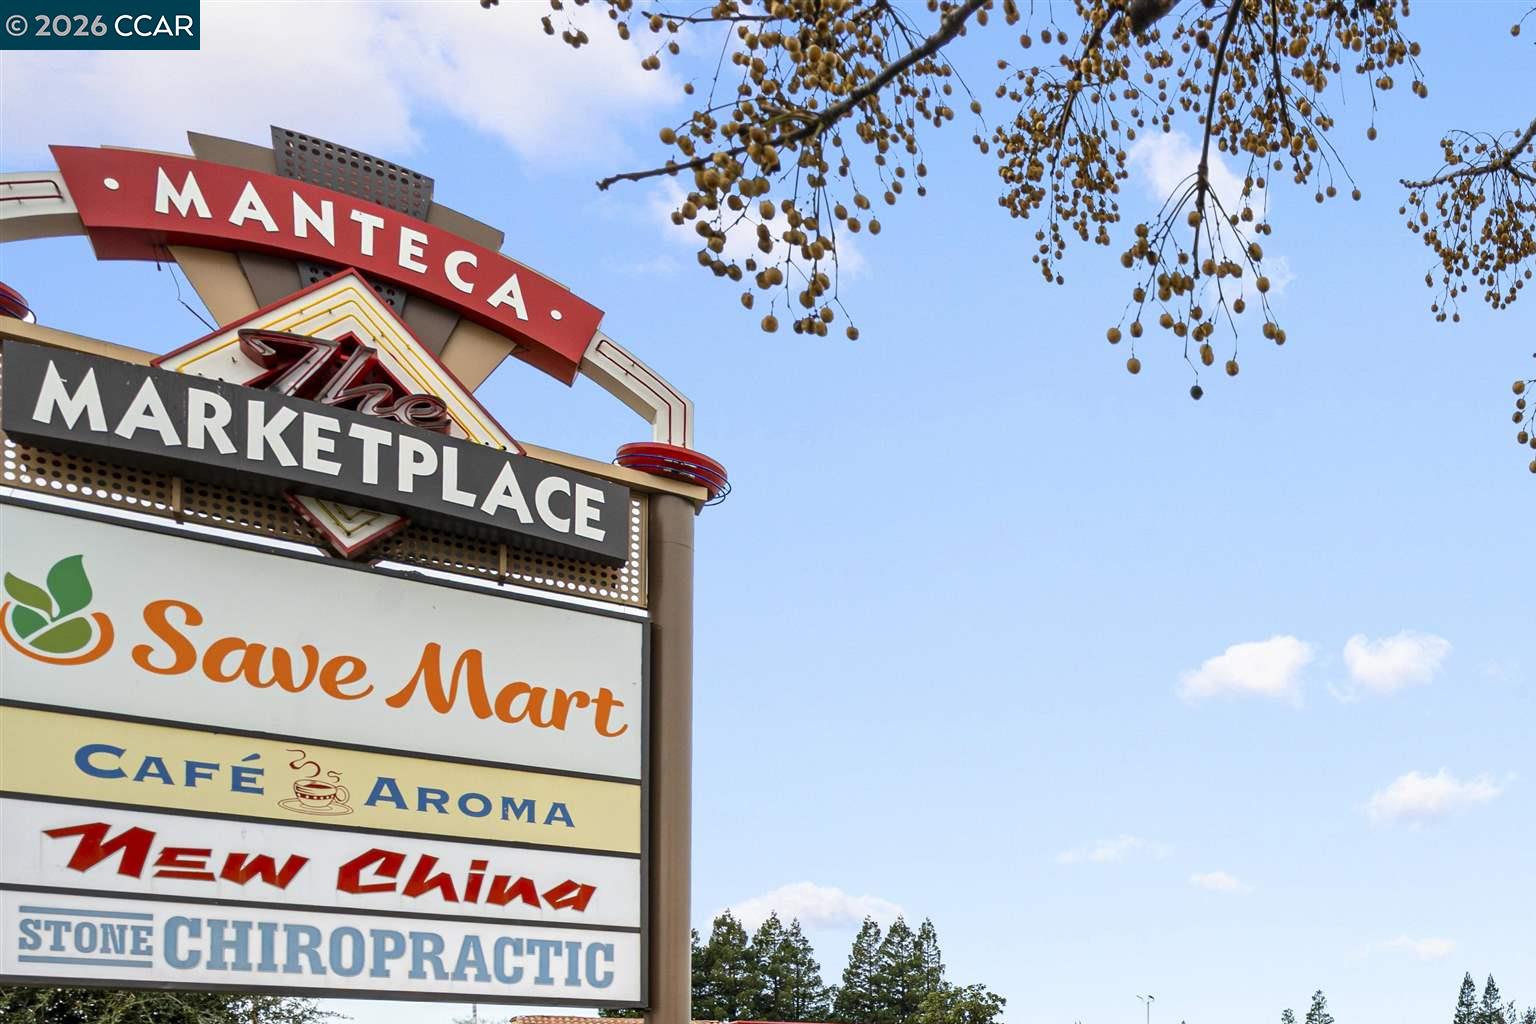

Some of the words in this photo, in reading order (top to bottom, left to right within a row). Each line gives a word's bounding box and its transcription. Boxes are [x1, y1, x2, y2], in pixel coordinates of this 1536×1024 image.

[153, 165, 530, 322] MANTECA
[238, 329, 452, 434] The
[31, 359, 607, 543] MARKETPLACE
[131, 599, 374, 702] Save
[385, 642, 629, 738] Mart
[363, 776, 576, 828] AROMA
[335, 847, 598, 913] China
[18, 918, 154, 957] STONE
[163, 914, 616, 989] CHIROPRACTIC
